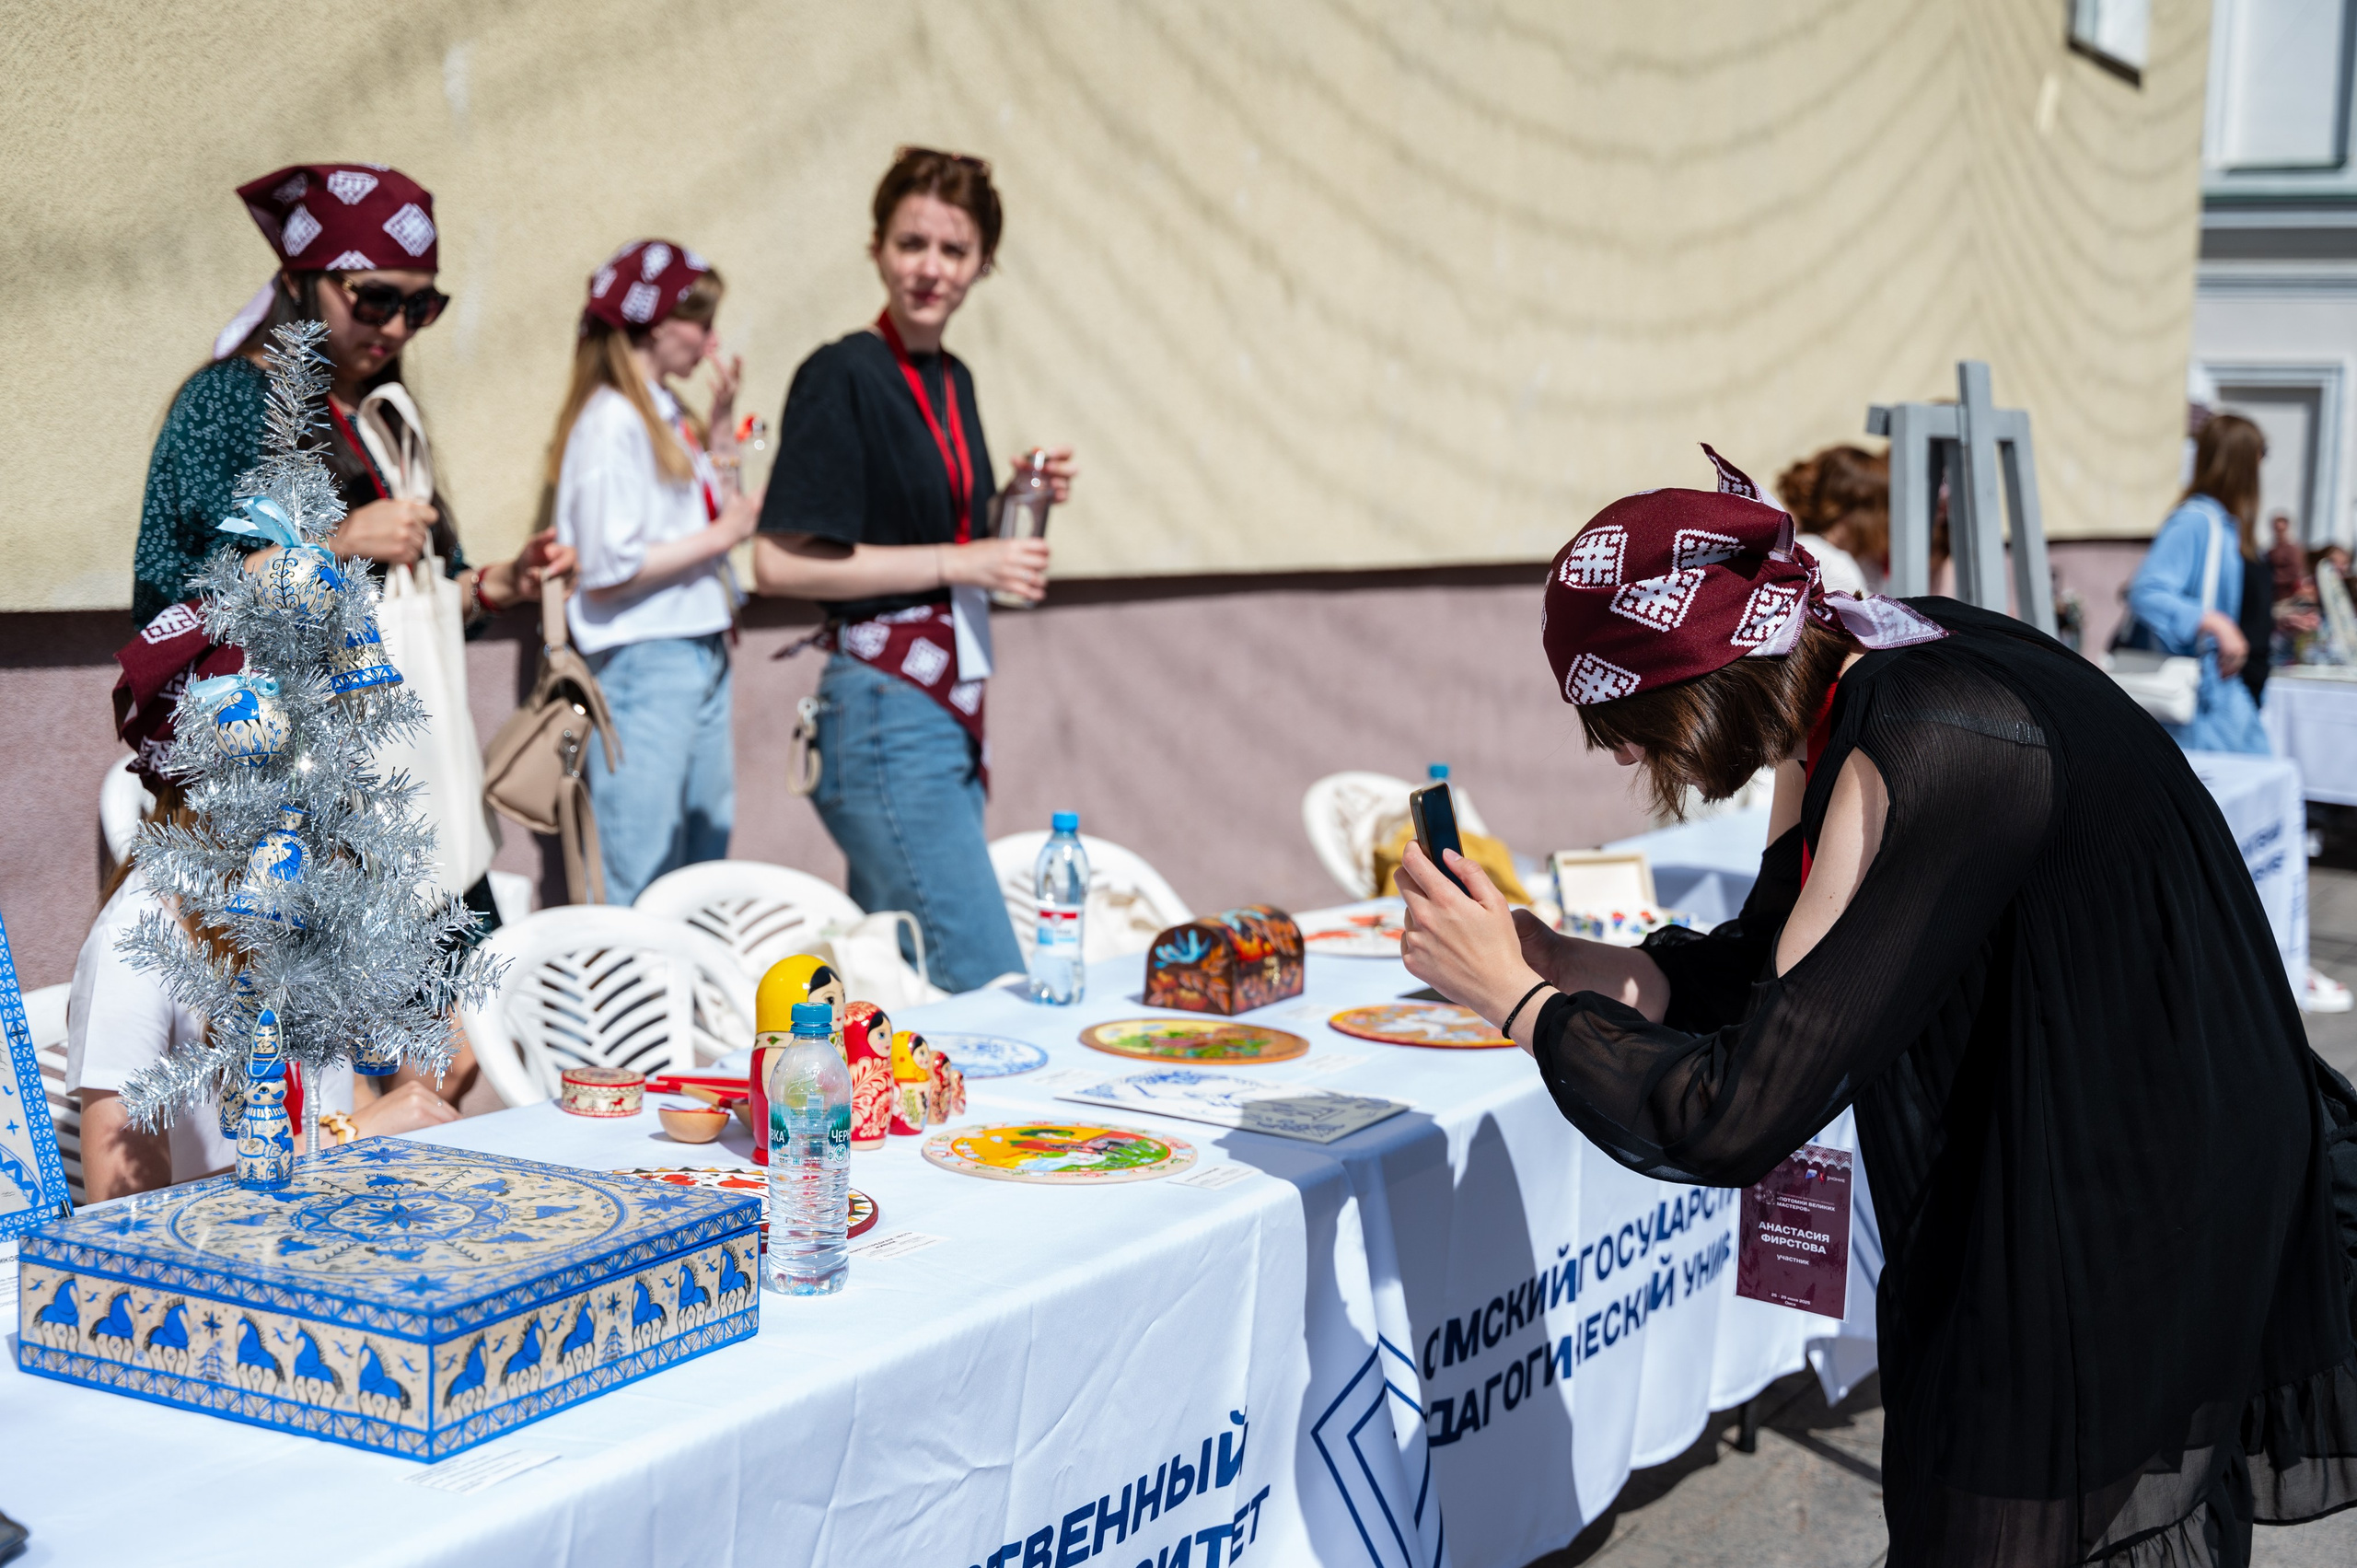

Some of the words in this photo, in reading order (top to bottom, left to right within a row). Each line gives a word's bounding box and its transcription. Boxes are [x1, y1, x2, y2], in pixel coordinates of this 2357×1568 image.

[1808, 1202, 1835, 1212] ВЕЛИКИХ
[1759, 1221, 1829, 1243] АНАСТАСИЯ
[1760, 1233, 1827, 1255] ФИРСТОВА
[1777, 1254, 1809, 1266] участник
